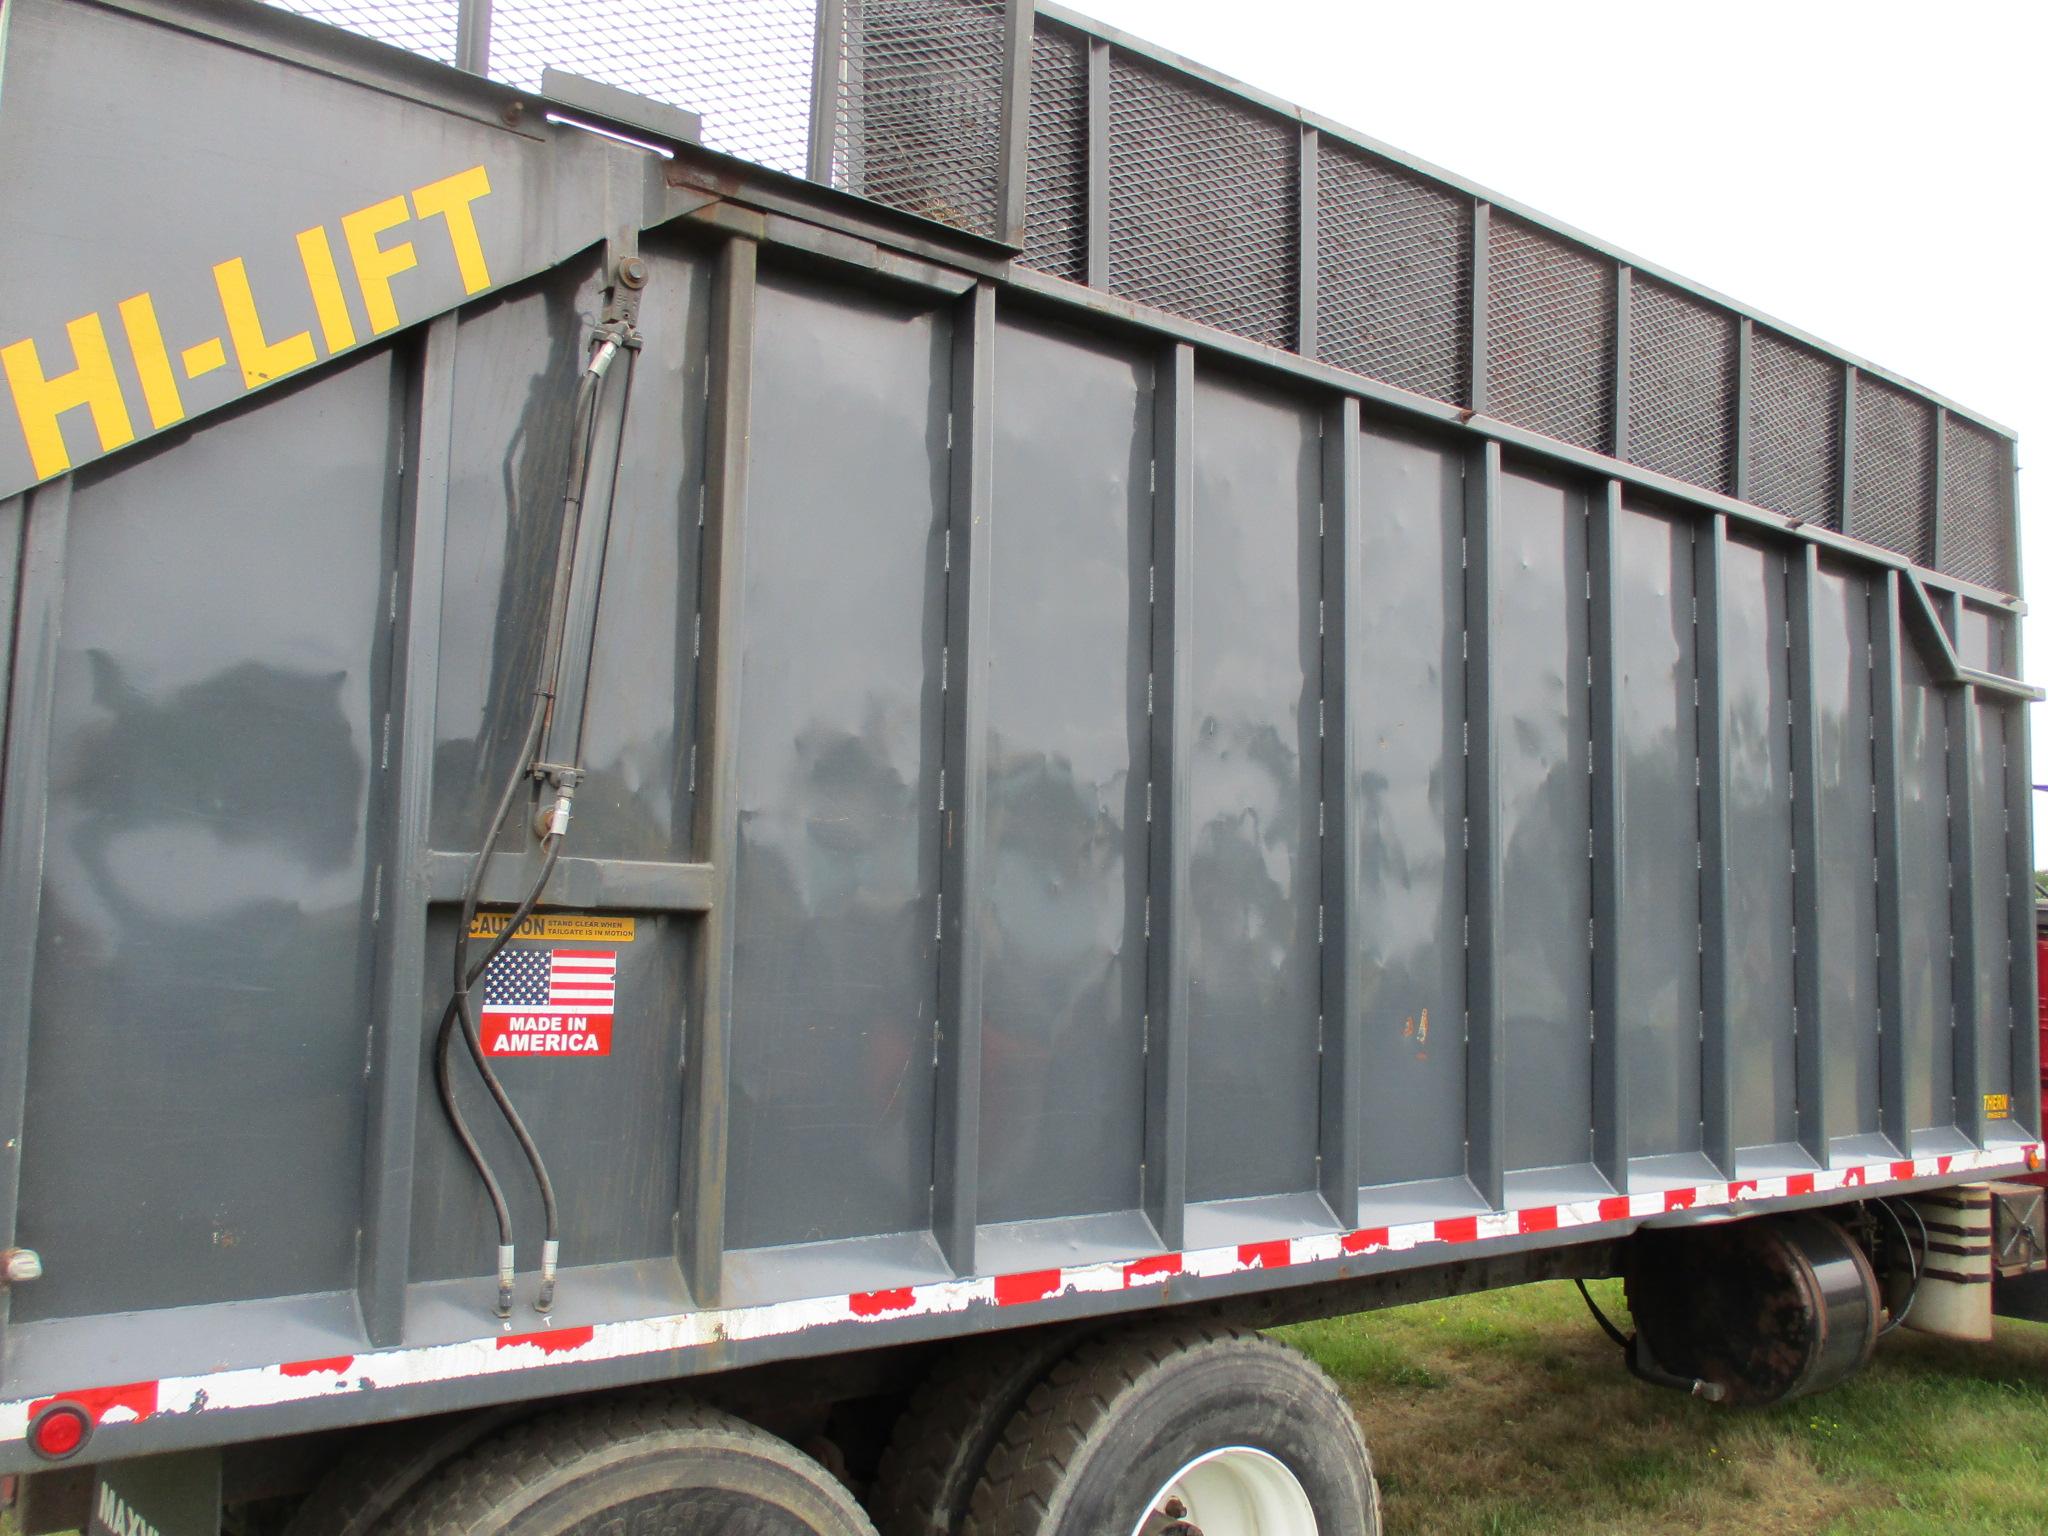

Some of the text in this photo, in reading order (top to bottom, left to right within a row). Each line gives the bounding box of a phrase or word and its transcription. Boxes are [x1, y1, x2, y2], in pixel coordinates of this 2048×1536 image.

[0, 165, 491, 480] HI-LIFT
[600, 921, 623, 929] WHEN
[509, 1016, 588, 1031] MADE IN
[492, 1033, 600, 1052] AMERICA
[543, 1315, 553, 1328] T
